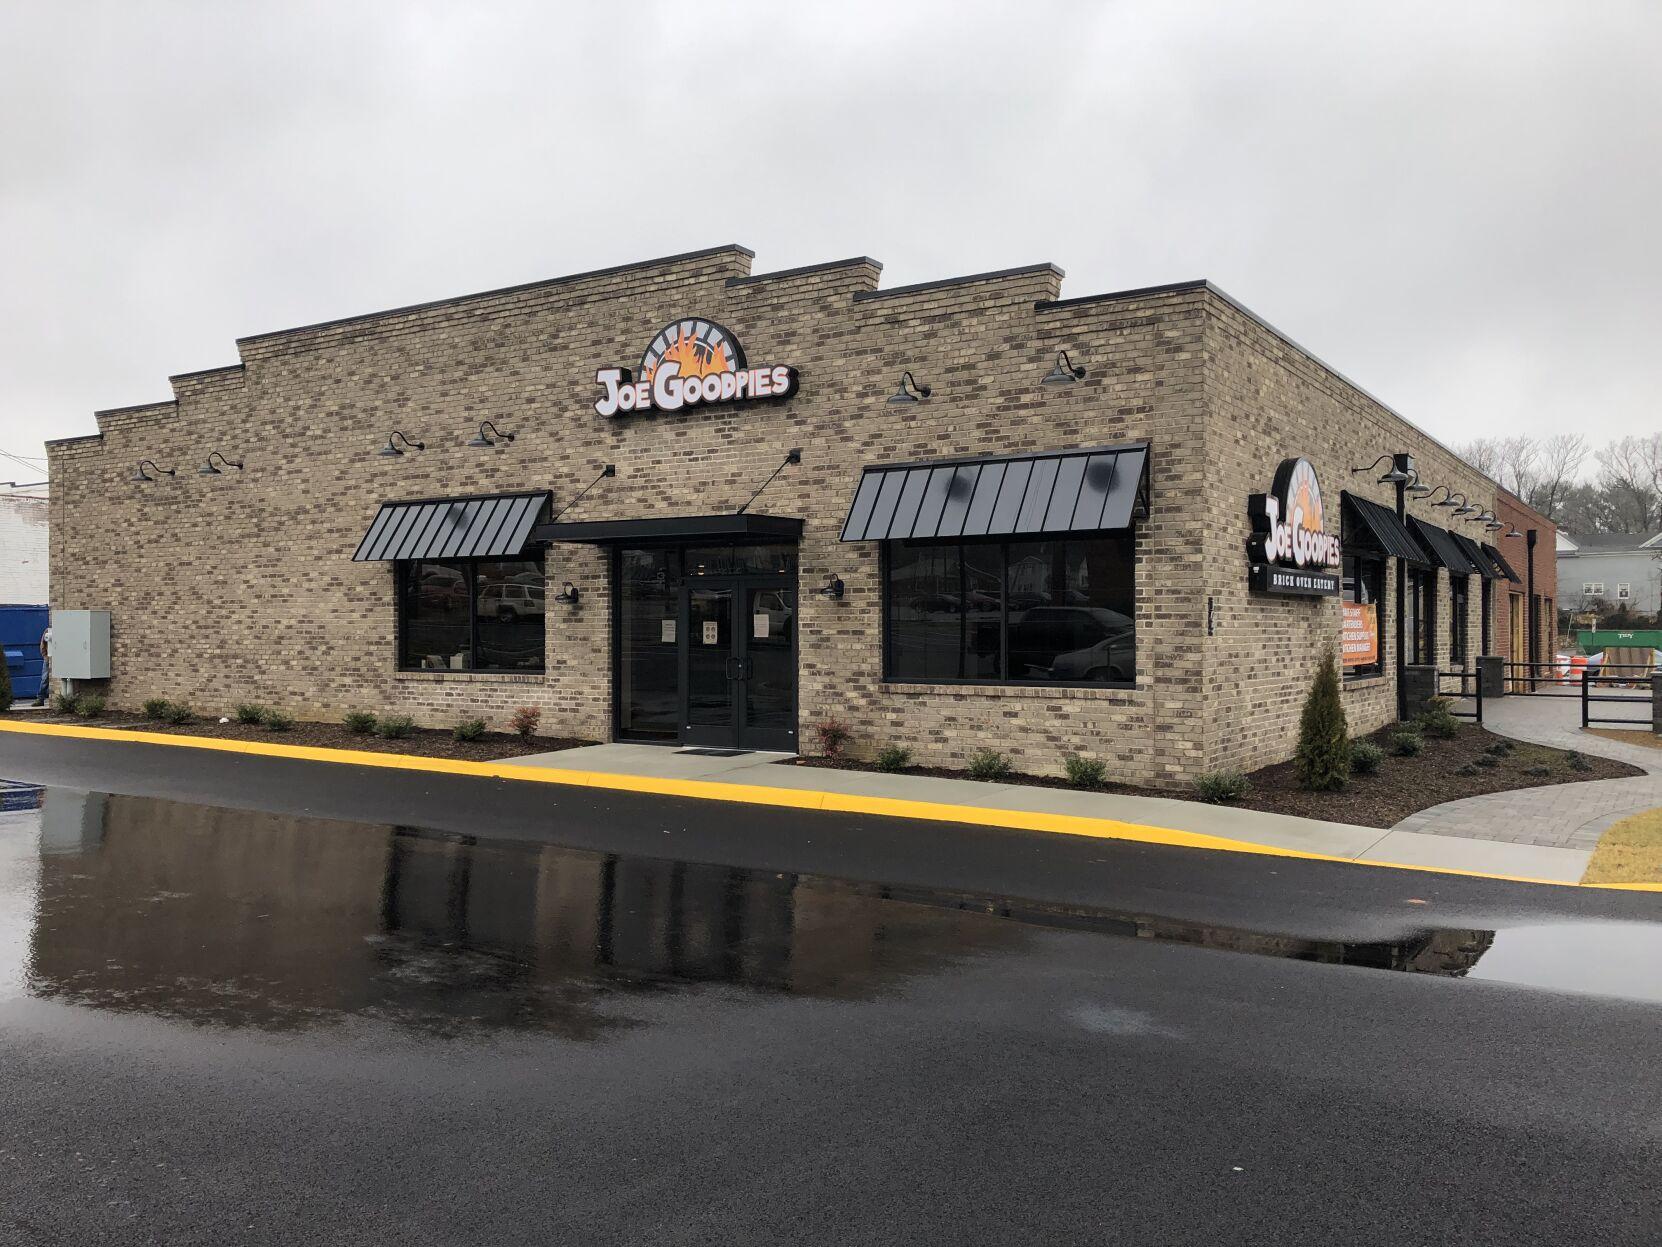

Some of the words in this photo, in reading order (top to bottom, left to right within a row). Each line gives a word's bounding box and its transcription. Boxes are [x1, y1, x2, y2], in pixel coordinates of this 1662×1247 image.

[594, 368, 651, 417] JOE
[653, 361, 790, 410] GOODPIES
[1265, 496, 1292, 563] JOE
[1293, 506, 1340, 566] GOODPIES
[1273, 573, 1295, 587] BRICK
[1296, 576, 1312, 588] OVEN
[1313, 578, 1335, 590] EATERY
